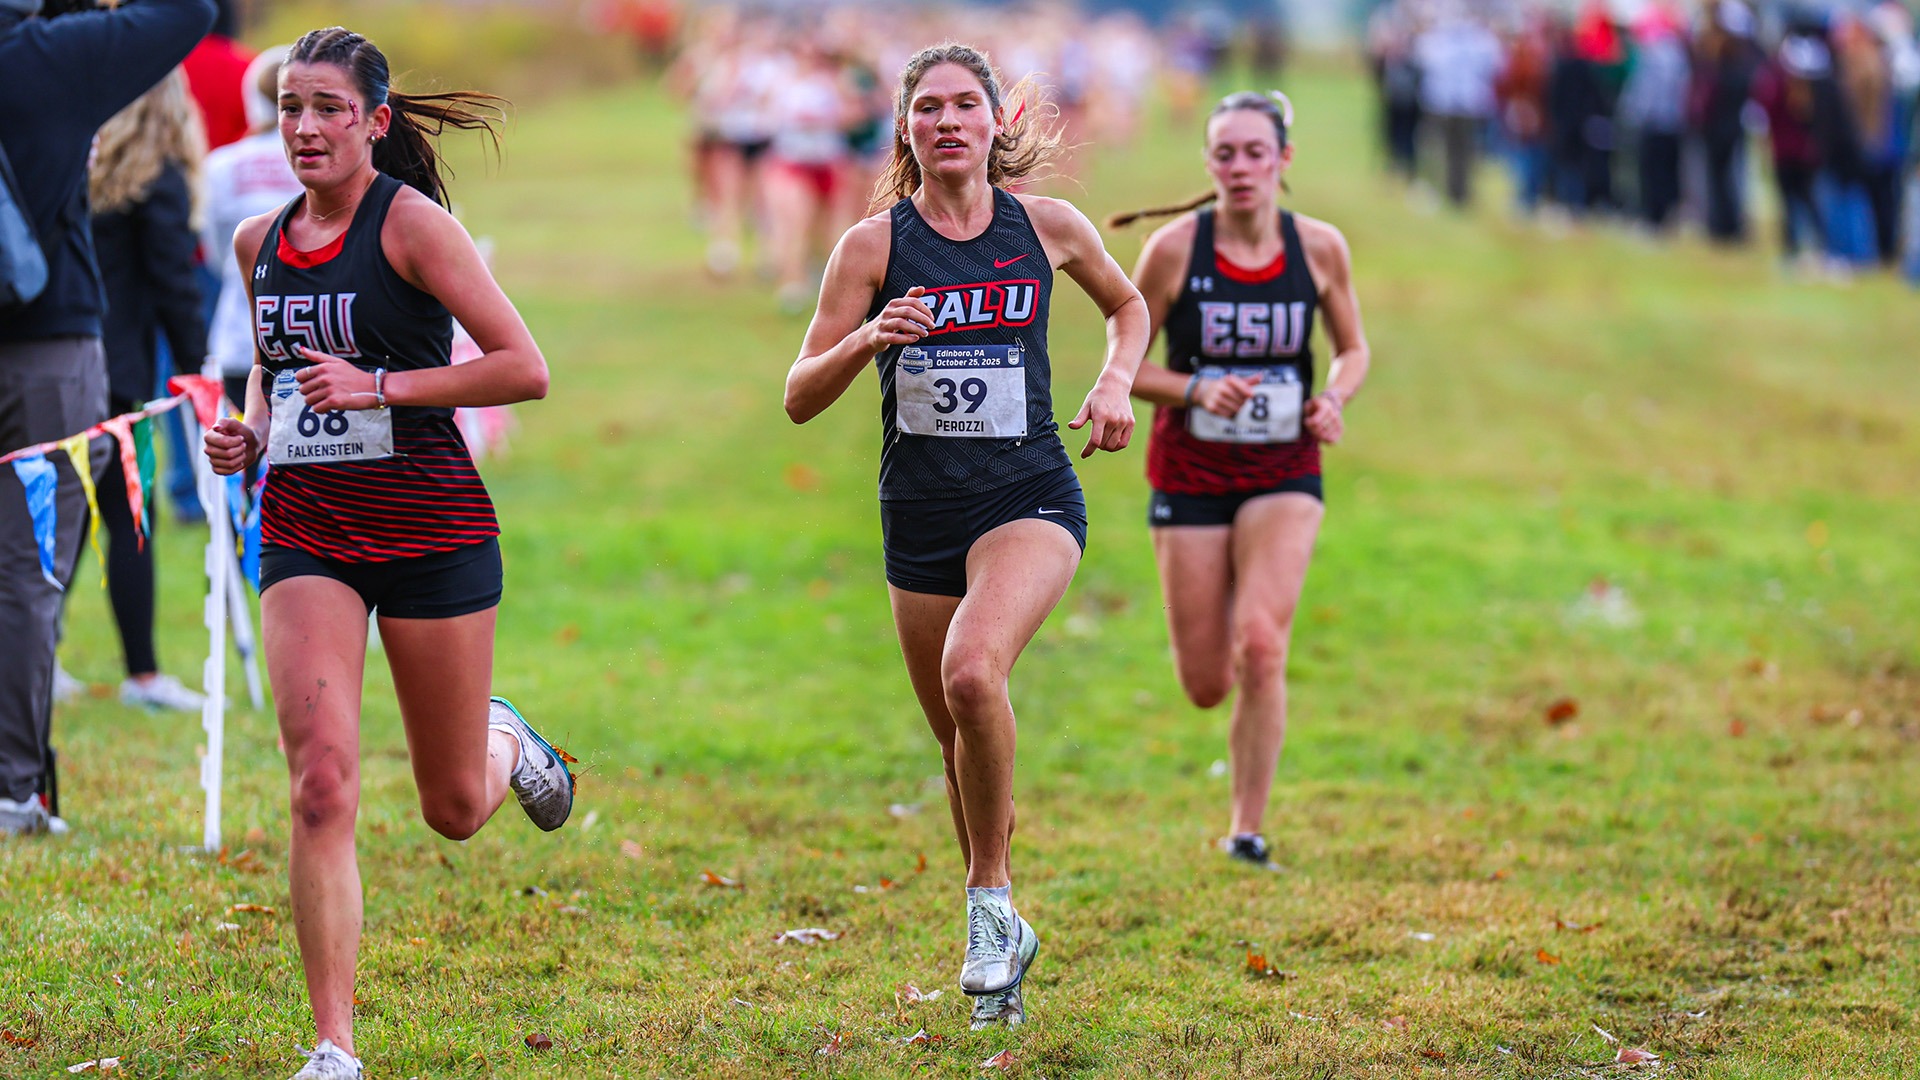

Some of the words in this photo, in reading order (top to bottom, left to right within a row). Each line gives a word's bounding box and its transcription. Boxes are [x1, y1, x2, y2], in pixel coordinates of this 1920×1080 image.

[1005, 285, 1034, 320] U
[256, 293, 362, 361] ESU
[1199, 301, 1306, 358] ESU
[936, 349, 972, 358] Edinboro,
[974, 349, 985, 357] PA
[936, 359, 967, 367] October
[968, 359, 980, 367] 25,
[981, 358, 1001, 366] 2025
[932, 377, 988, 414] 39
[1250, 392, 1269, 422] 8
[297, 405, 349, 437] 68
[935, 419, 984, 432] PEROZZI
[287, 442, 364, 458] FALKENSTEIN
